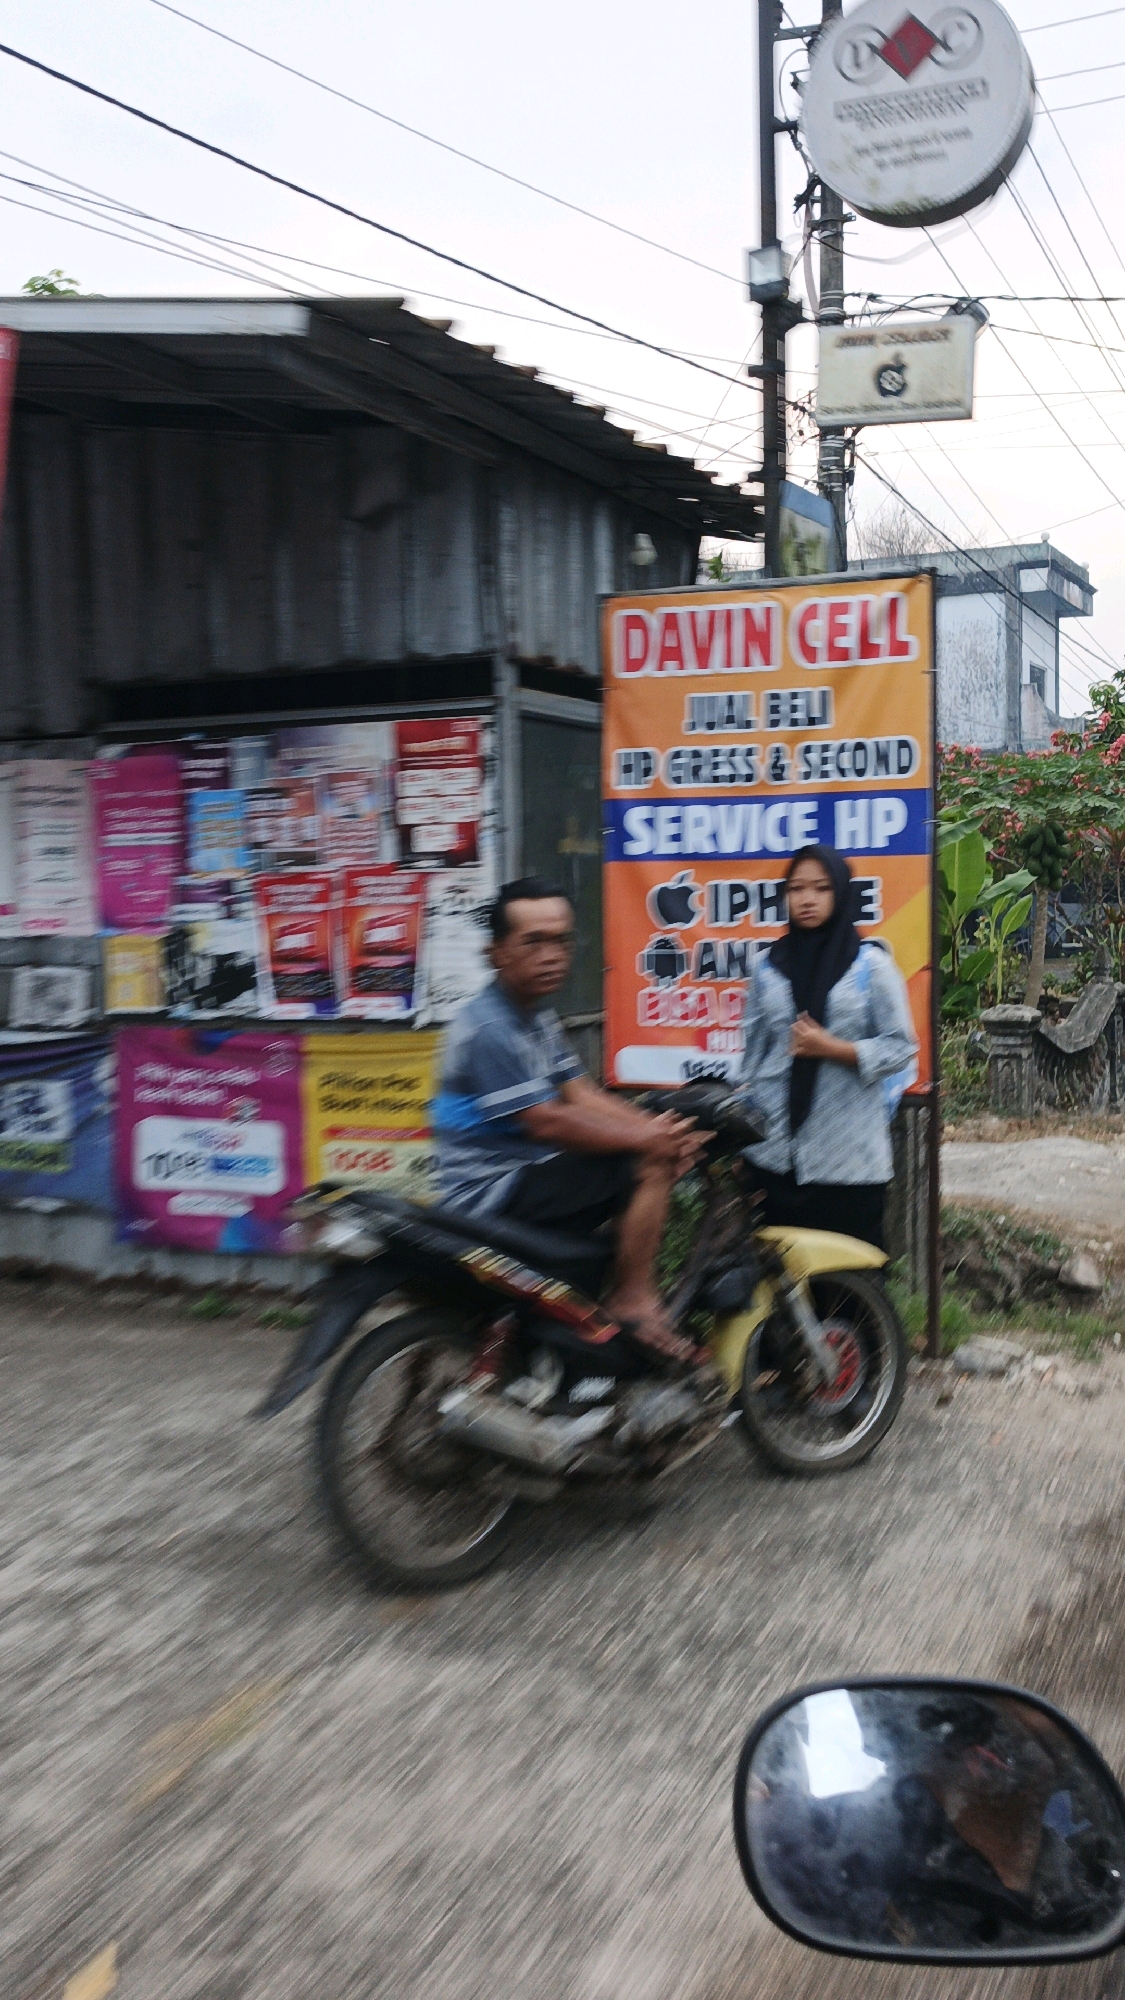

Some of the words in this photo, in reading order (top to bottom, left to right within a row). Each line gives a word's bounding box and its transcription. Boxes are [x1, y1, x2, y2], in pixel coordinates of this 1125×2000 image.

[613, 602, 781, 678] DAVIN
[789, 592, 919, 669] CELL
[683, 691, 757, 734] JUAL
[760, 686, 834, 731] BELI
[611, 748, 661, 789] HP
[766, 742, 793, 785] &
[795, 736, 919, 781] SECOND
[623, 801, 819, 855] SERVICE
[834, 797, 908, 850] HP
[705, 876, 882, 927] IPHE
